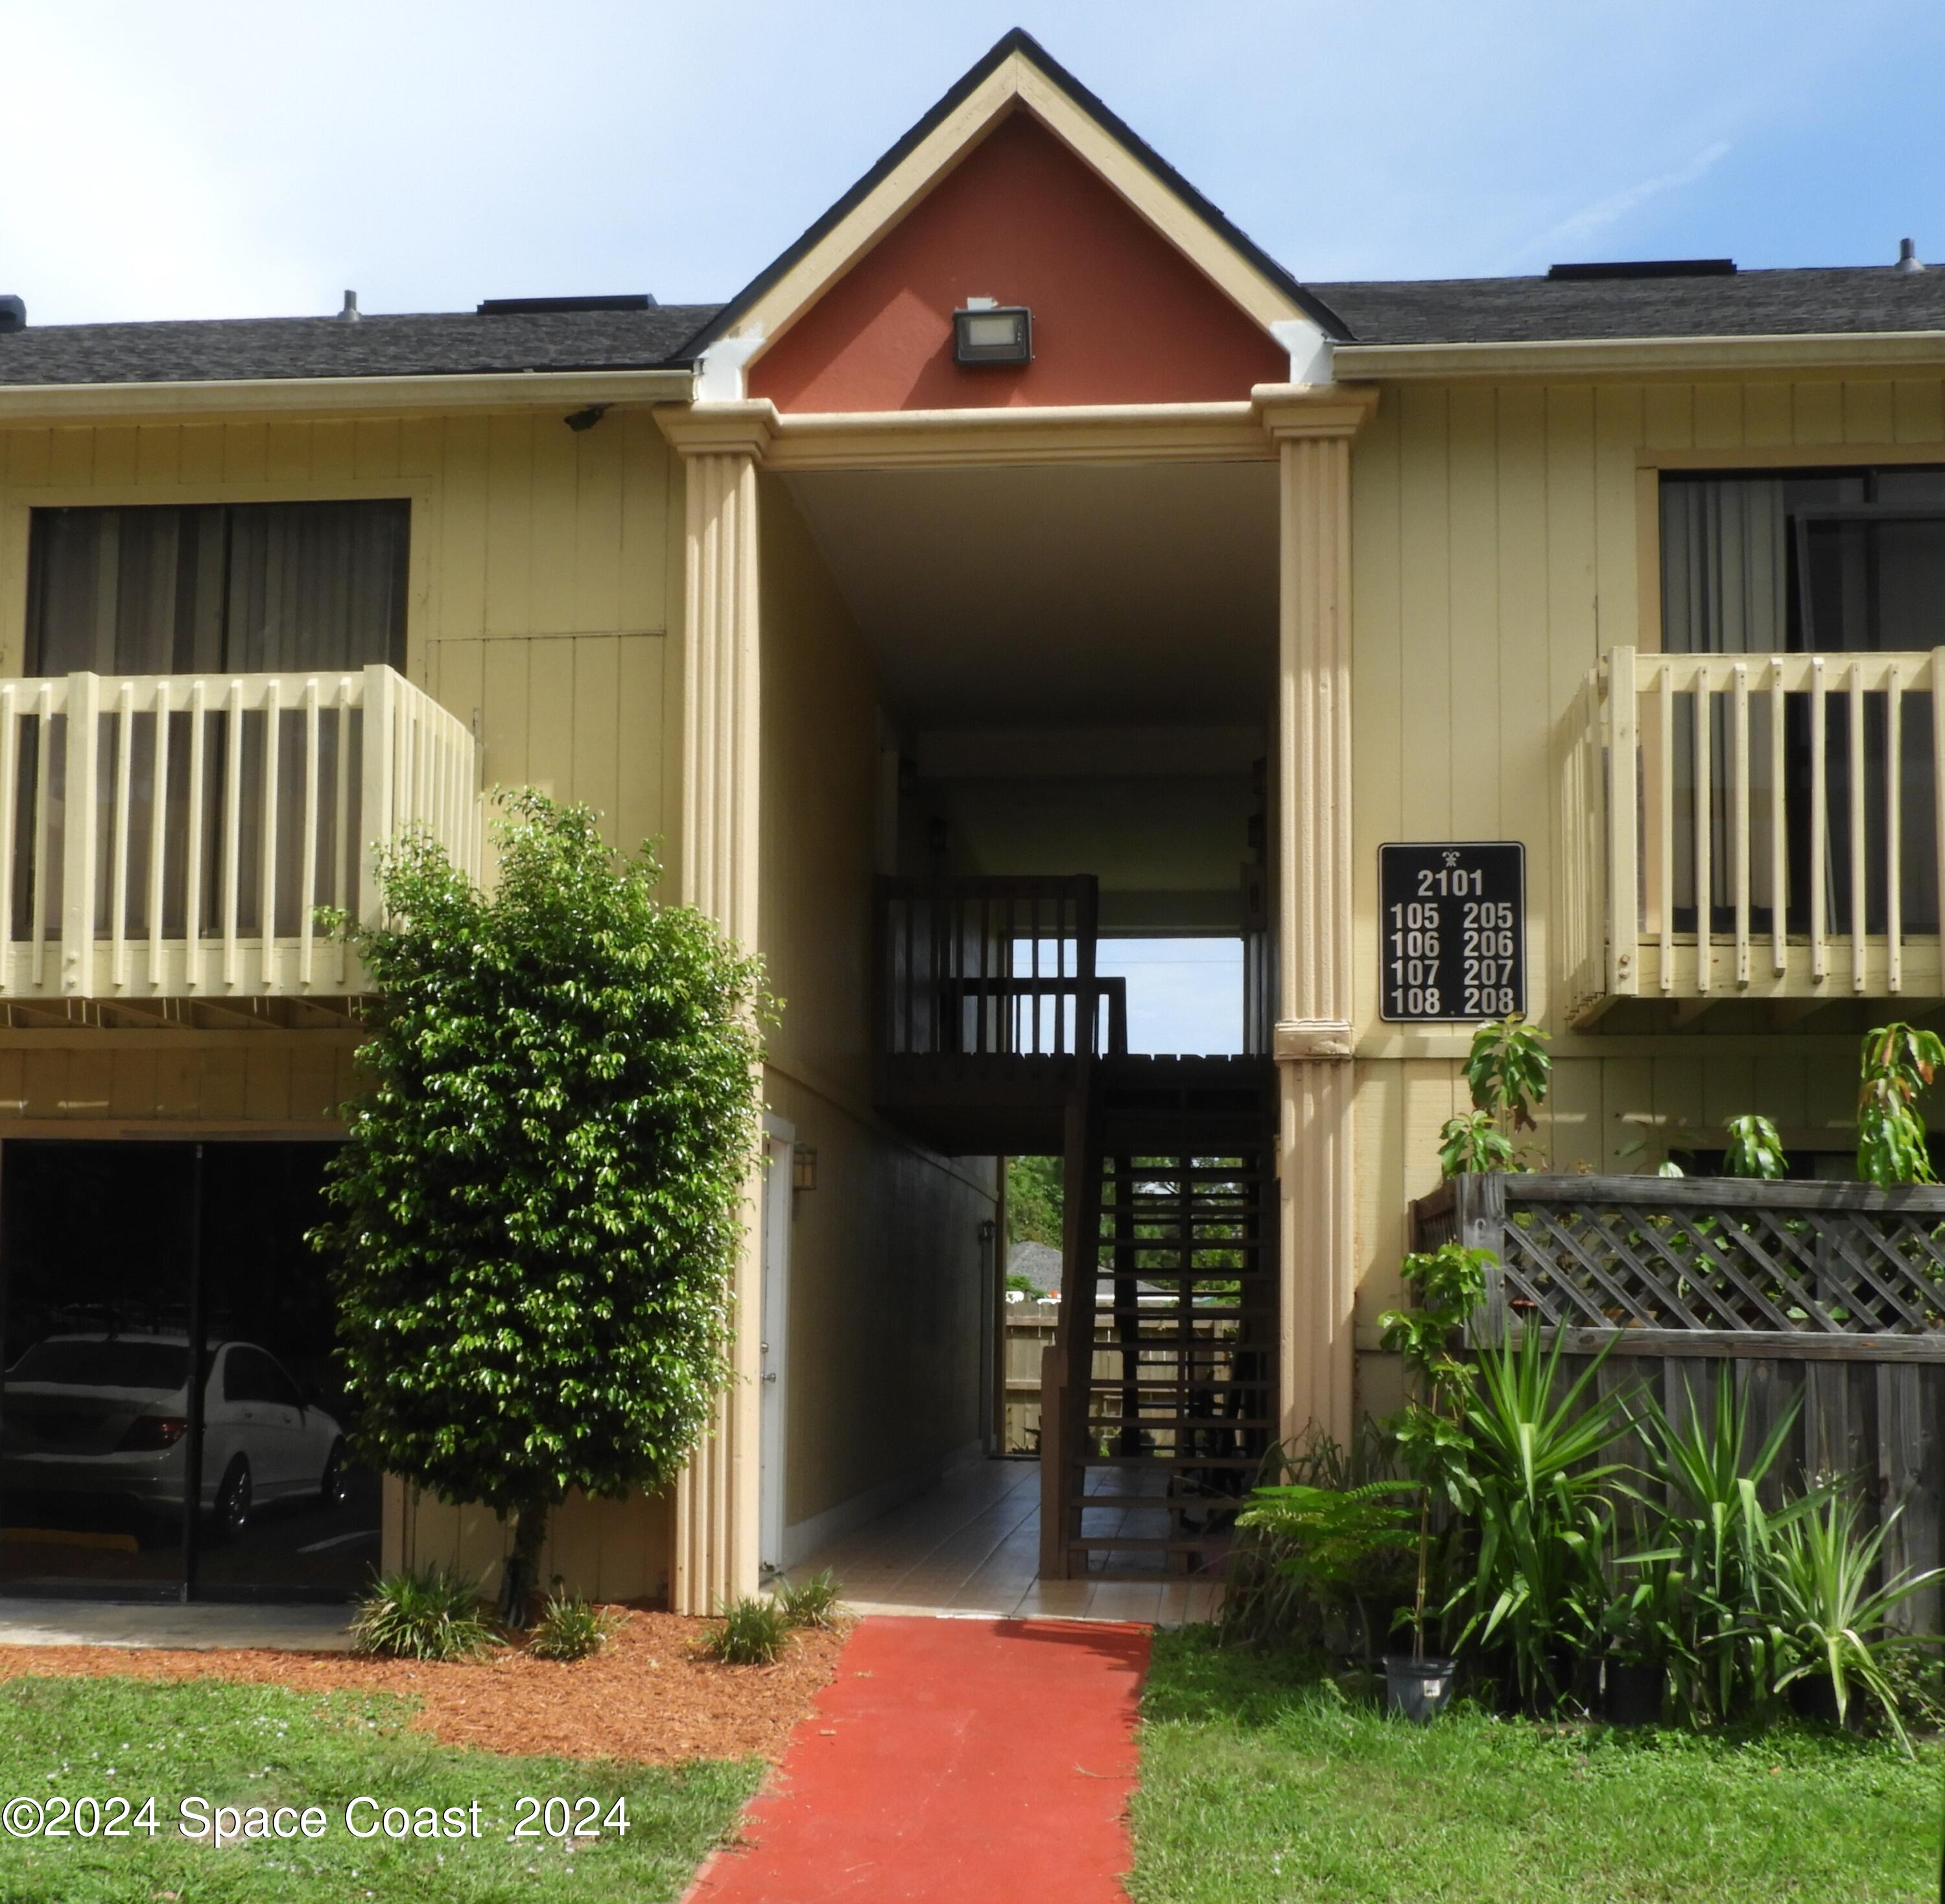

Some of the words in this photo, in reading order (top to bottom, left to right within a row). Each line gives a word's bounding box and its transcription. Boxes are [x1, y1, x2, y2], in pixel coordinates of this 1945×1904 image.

[1417, 869, 1482, 896] 2101
[1390, 902, 1439, 929] 105
[1463, 902, 1513, 928] 205
[1390, 931, 1440, 957] 106
[1463, 930, 1513, 957] 206
[1391, 959, 1440, 985] 107
[1464, 959, 1513, 985] 207
[1391, 987, 1441, 1014] 108
[1464, 987, 1515, 1014] 208
